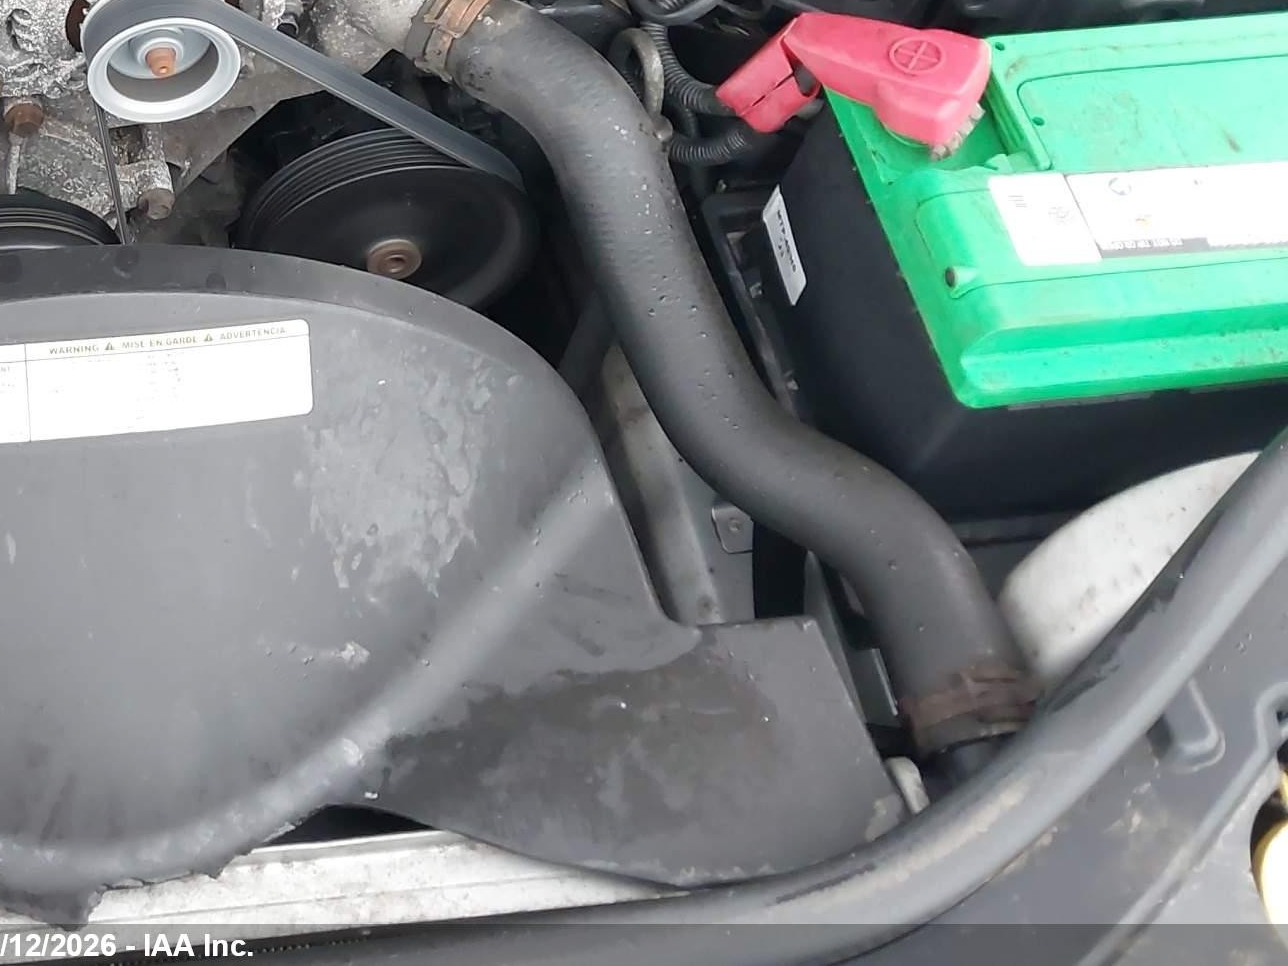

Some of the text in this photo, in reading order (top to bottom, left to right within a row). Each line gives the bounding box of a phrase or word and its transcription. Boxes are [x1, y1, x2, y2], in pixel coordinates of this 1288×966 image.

[49, 326, 287, 355] WARNING MISE EN GARDE ADVERTENCIA
